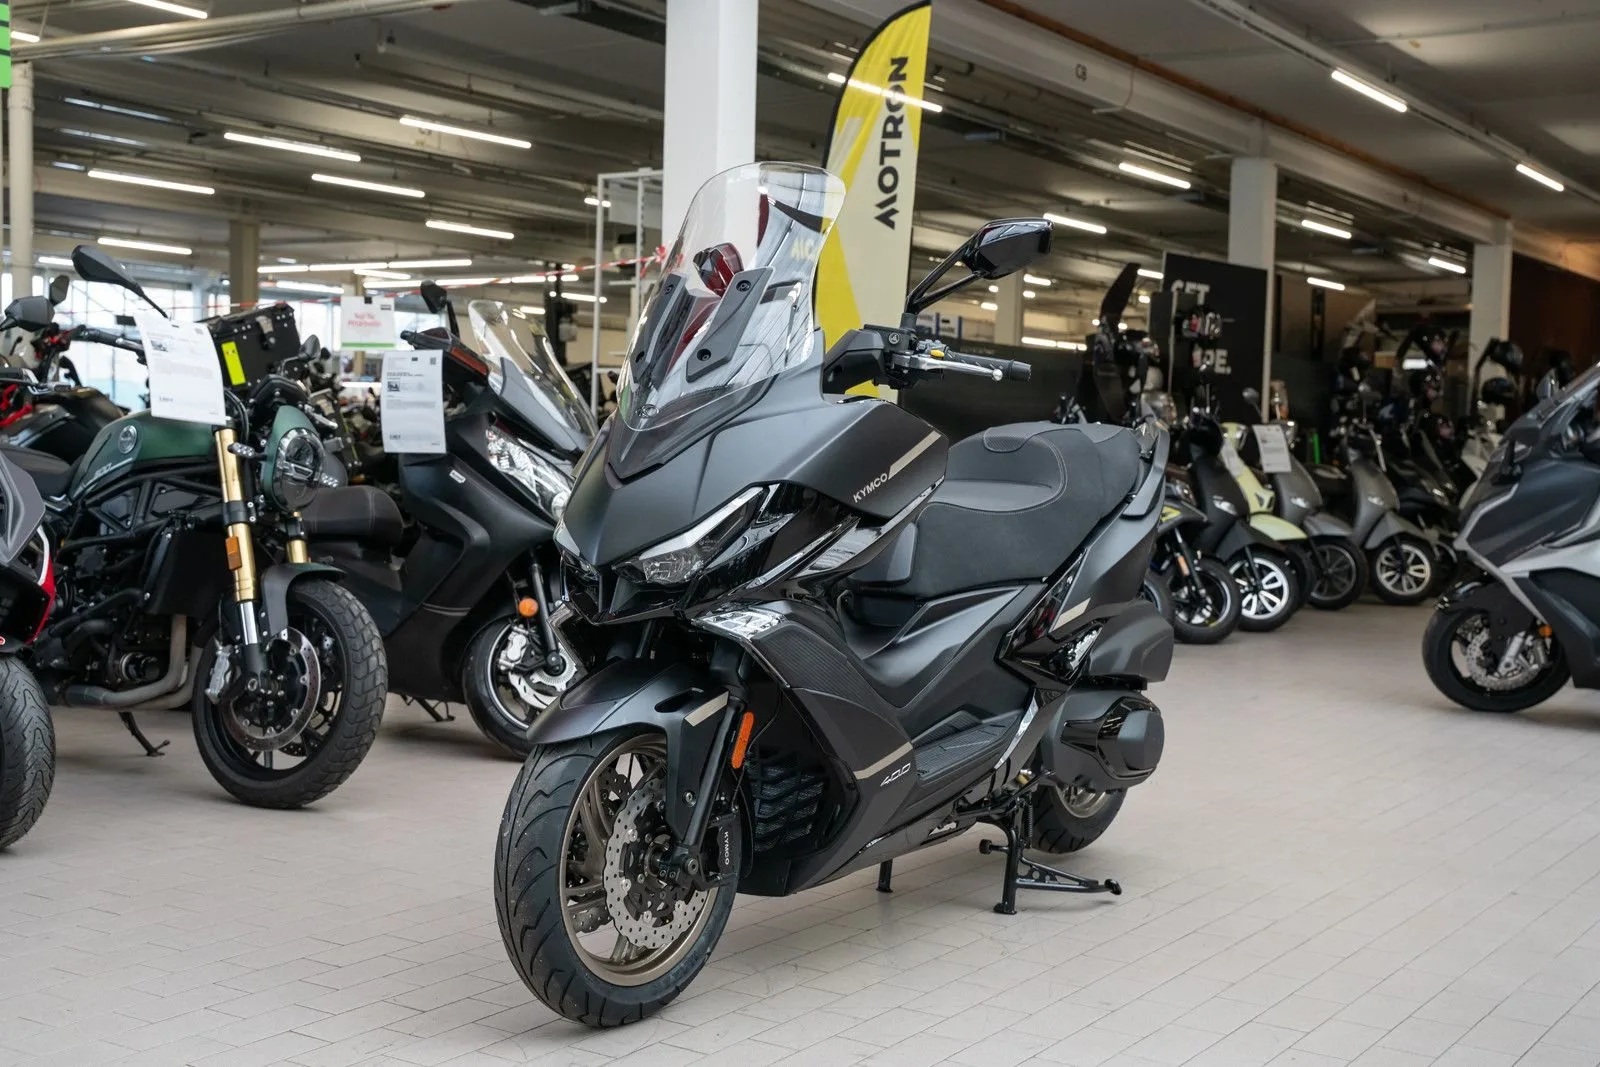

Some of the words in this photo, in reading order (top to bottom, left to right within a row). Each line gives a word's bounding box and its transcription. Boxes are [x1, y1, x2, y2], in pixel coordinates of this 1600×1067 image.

[874, 56, 909, 230] MOTRON
[853, 473, 888, 503] KYMCO
[880, 763, 911, 787] 400
